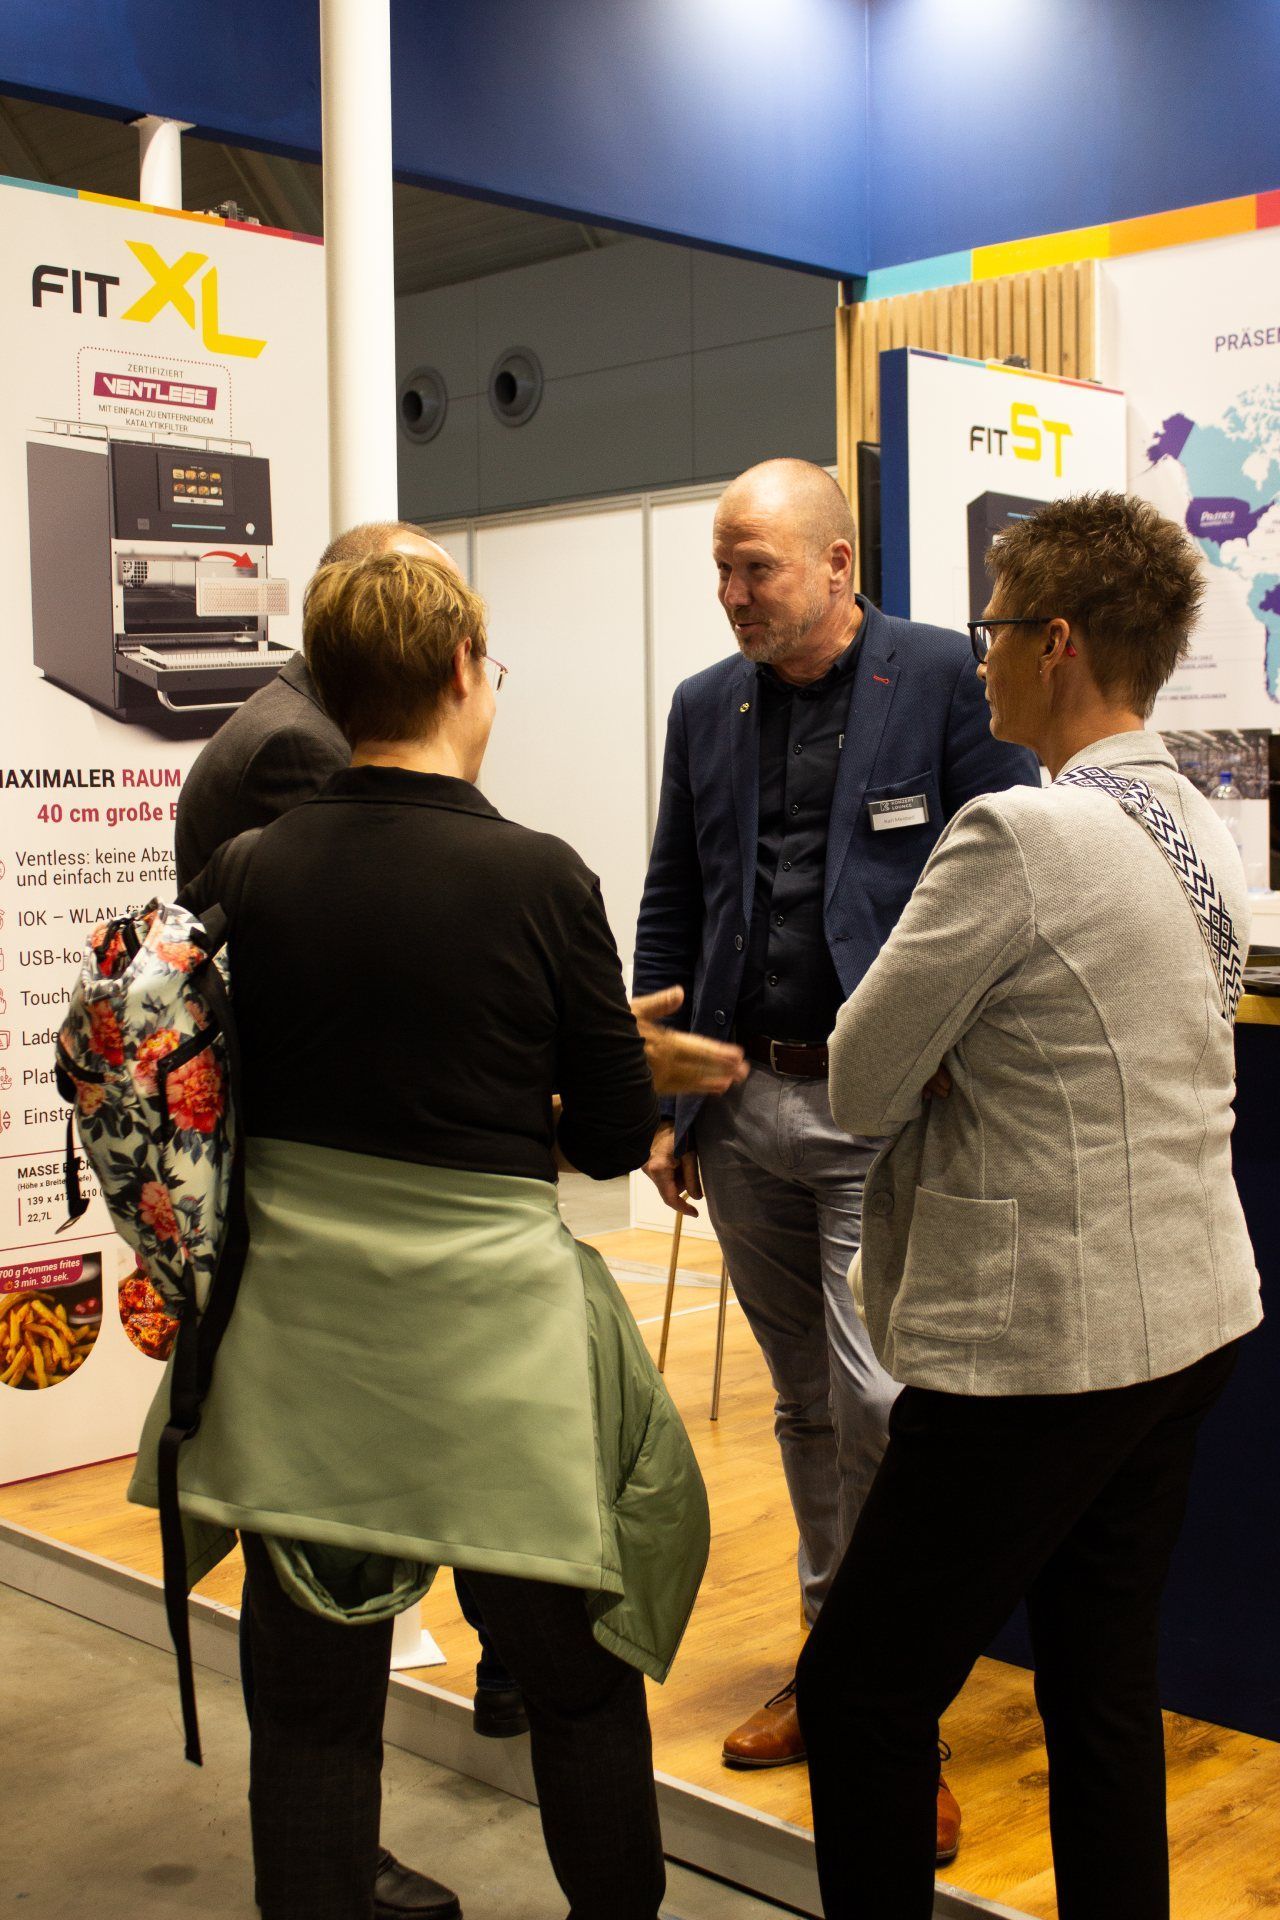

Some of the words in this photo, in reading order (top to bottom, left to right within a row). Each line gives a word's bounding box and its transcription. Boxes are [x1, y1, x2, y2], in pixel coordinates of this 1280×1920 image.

[32, 264, 120, 318] FIT
[120, 239, 268, 359] XL
[1215, 326, 1280, 353] PRÄSE
[127, 364, 184, 379] ZERTIFIZIERT
[103, 376, 208, 406] VENTLESS
[98, 404, 111, 413] MIT
[114, 405, 145, 417] EINFACH
[146, 409, 156, 418] ZU
[157, 411, 214, 425] ENTFERNENDEM
[126, 418, 189, 433] KATALYTIKFILTER
[969, 424, 1008, 457] FIT
[1010, 402, 1074, 478] ST
[0, 768, 116, 789] AXIMALER
[37, 803, 63, 823] 40
[70, 807, 99, 823] cm
[106, 801, 163, 827] große
[16, 850, 90, 867] Ventless:
[95, 848, 136, 865] keine
[17, 870, 47, 887] und
[53, 867, 111, 885] einfach
[116, 869, 134, 883] zu
[18, 910, 47, 927] IOK
[20, 987, 71, 1006] Touch
[22, 1028, 59, 1046] Lade
[23, 1068, 56, 1086] Plat
[24, 1107, 73, 1125] Einste
[17, 1163, 60, 1179] MASSE
[17, 1182, 38, 1192] (Höhe
[27, 1195, 44, 1206] 139
[81, 1188, 97, 1198] 410
[27, 1211, 52, 1223] 22,7L
[14, 1269, 21, 1279] g
[22, 1263, 58, 1276] Pommes
[60, 1259, 81, 1270] frites
[14, 1279, 20, 1289] 3
[21, 1277, 39, 1288] min.
[41, 1274, 52, 1285] 30
[53, 1271, 69, 1281] sek.
